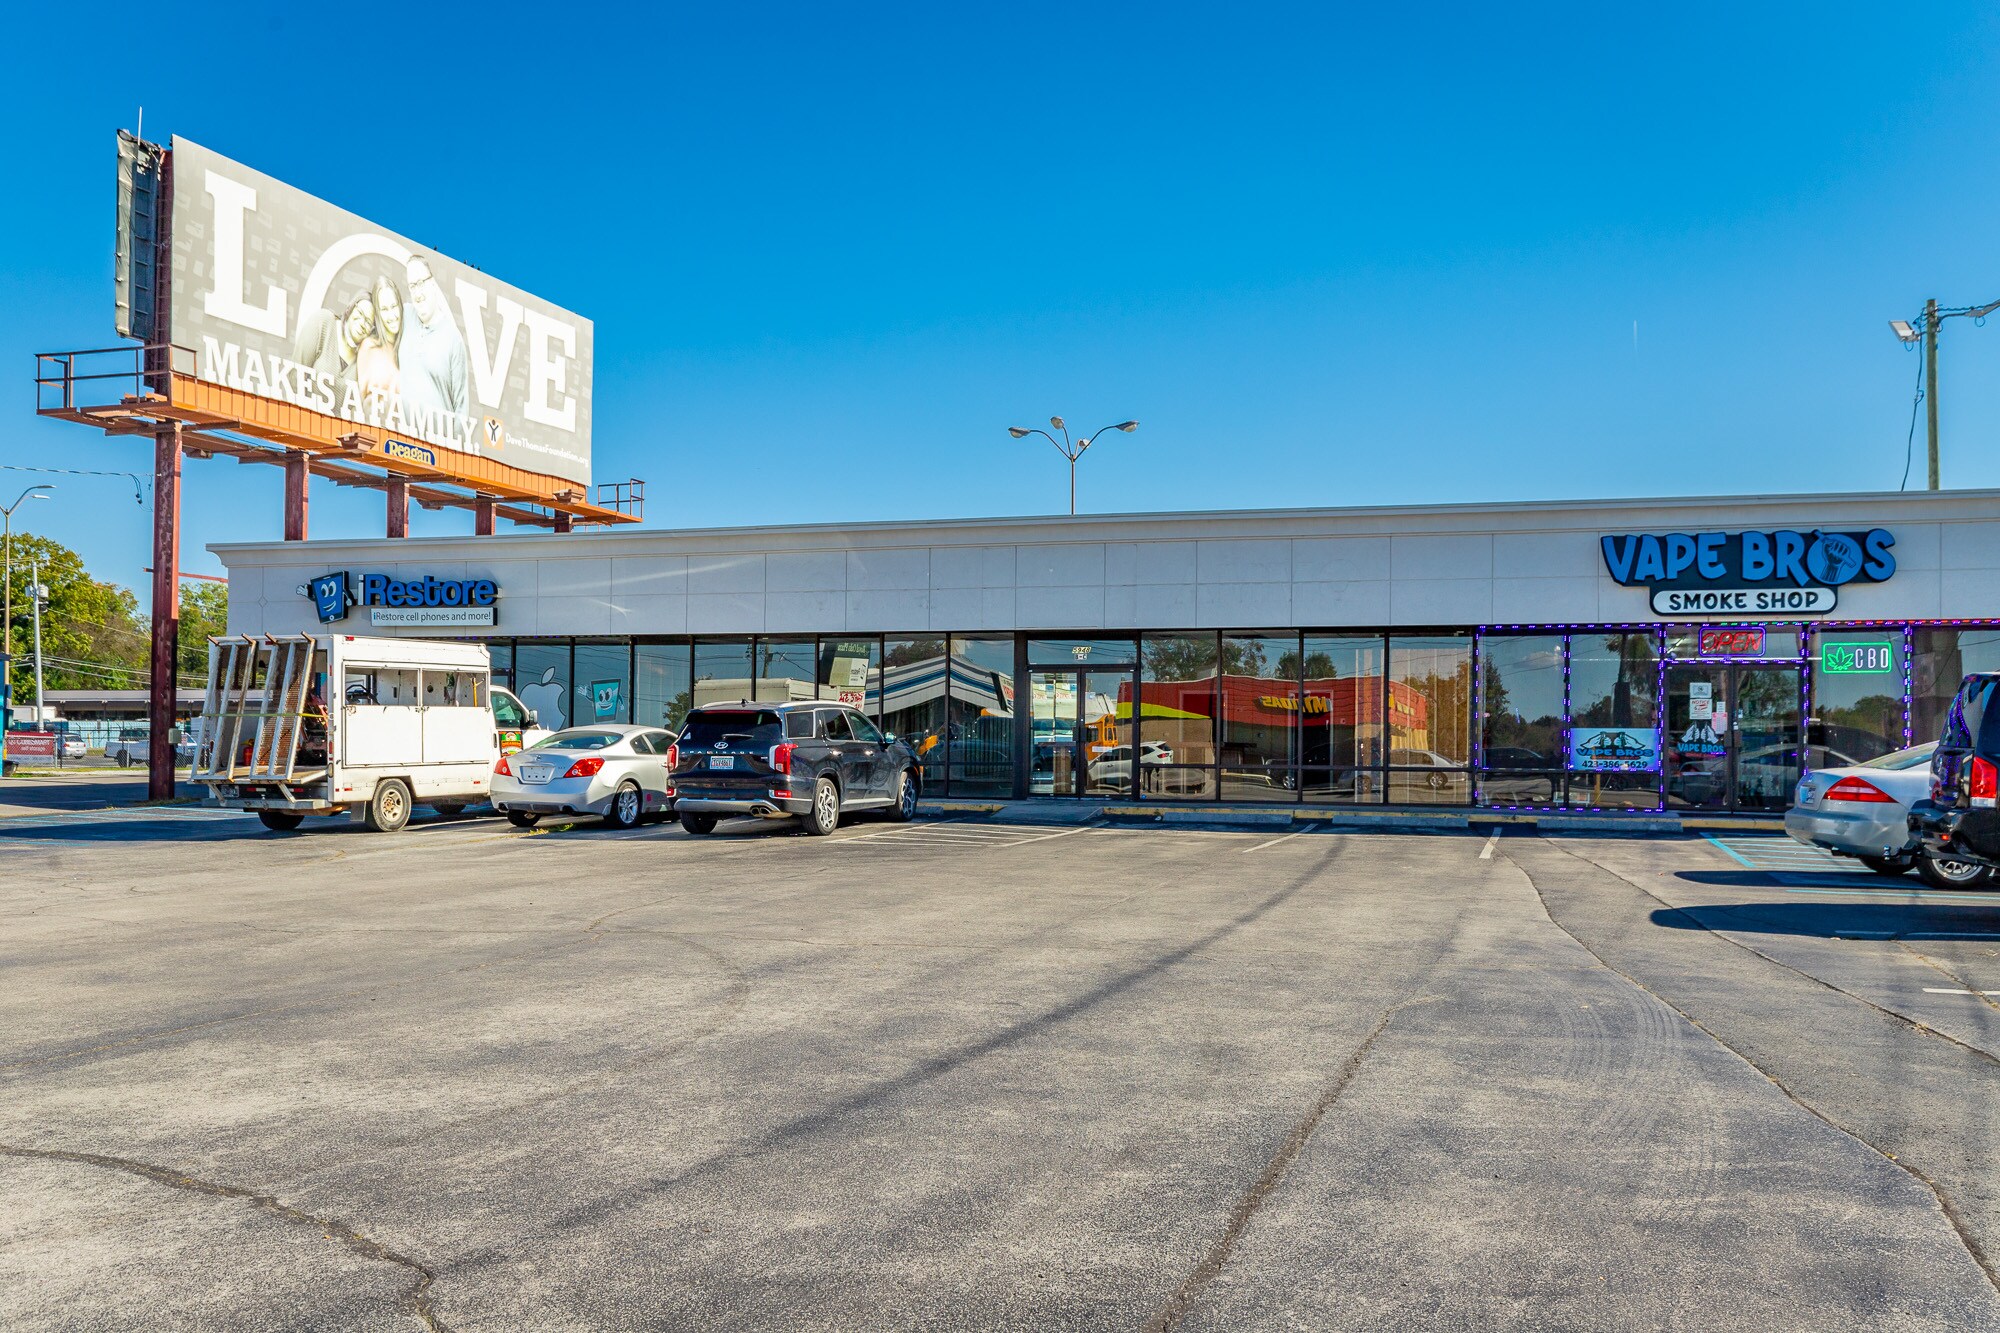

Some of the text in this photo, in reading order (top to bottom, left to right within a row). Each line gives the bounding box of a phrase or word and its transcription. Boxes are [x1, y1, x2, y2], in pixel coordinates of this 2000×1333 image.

[204, 169, 576, 433] LOVE
[203, 335, 337, 418] MAKES
[340, 379, 366, 424] A
[388, 440, 433, 464] Reagan
[505, 432, 589, 468] DaveThomasFoundation.org
[1601, 528, 1897, 587] VAPE BROS
[357, 574, 496, 607] iRestore
[1668, 591, 1820, 611] SMOKE SHOP
[373, 611, 492, 623] iRestore cell phones and more!
[1701, 631, 1764, 653] OPEN
[1855, 647, 1889, 669] CBD
[1576, 748, 1654, 757] VAPE BROS
[1677, 742, 1725, 753] VAPE BROS
